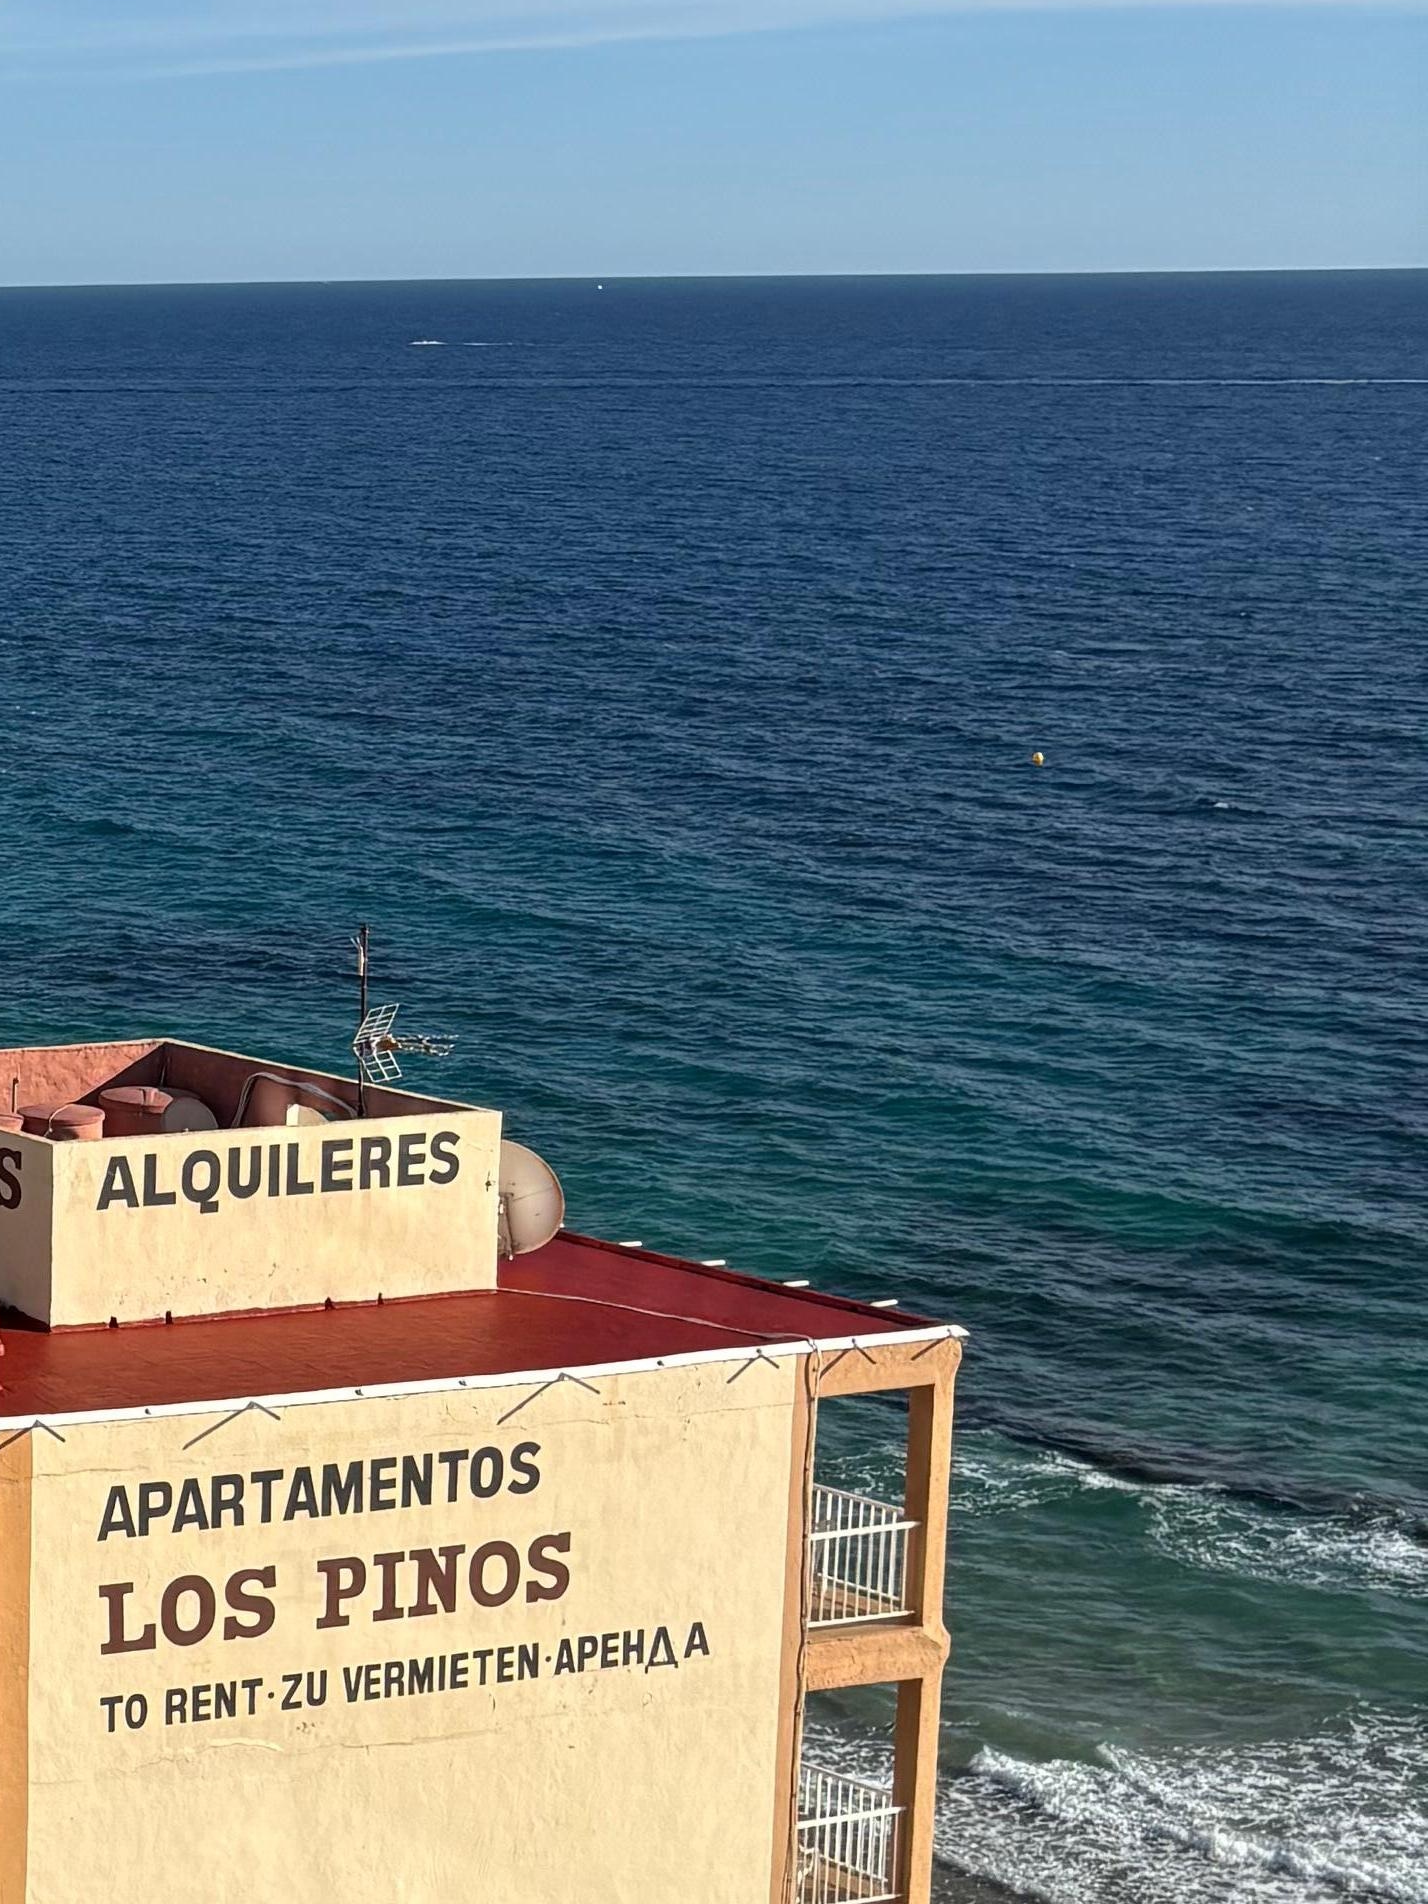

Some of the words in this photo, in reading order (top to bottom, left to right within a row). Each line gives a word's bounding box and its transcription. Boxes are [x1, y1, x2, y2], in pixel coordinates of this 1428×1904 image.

[96, 1129, 462, 1213] ALQUILERES
[97, 1440, 542, 1542] APARTAMENTOS
[99, 1564, 278, 1656] LOS
[315, 1531, 573, 1630] PINOS
[100, 1692, 148, 1733] TO
[343, 1642, 540, 1703] VERMIETEN
